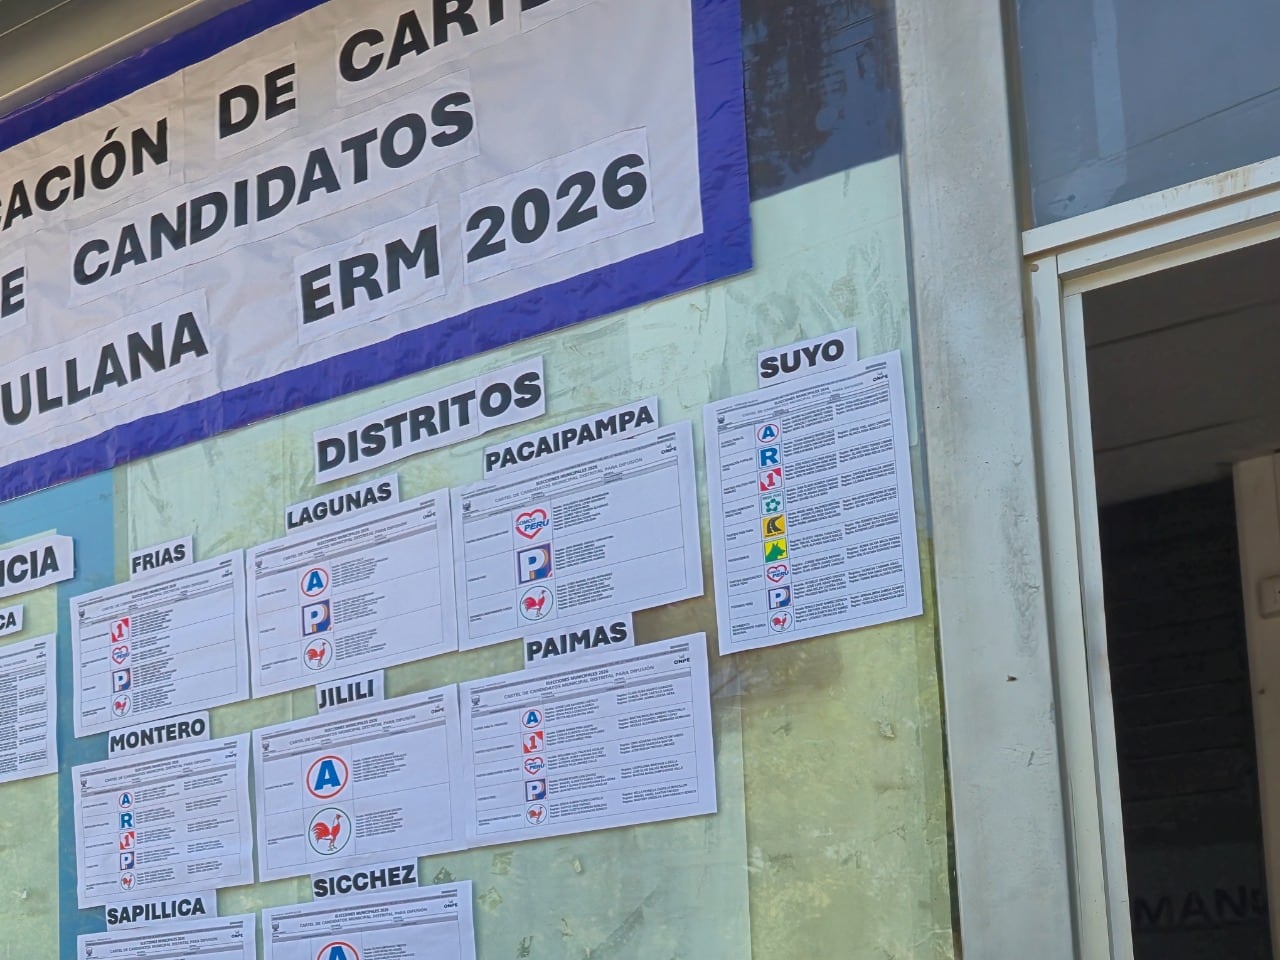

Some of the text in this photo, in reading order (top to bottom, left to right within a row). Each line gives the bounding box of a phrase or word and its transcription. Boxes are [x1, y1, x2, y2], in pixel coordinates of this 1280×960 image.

[219, 63, 296, 139] DE
[338, 0, 549, 82] CAR
[73, 91, 473, 286] CANDIDATOS
[300, 226, 440, 324] ERM
[466, 153, 648, 263] 2026
[759, 338, 844, 379] SUYO
[317, 370, 542, 472] DISTRITOS
[761, 425, 776, 441] A
[485, 406, 655, 472] PACAIPAMPA
[760, 447, 779, 467] R
[286, 482, 392, 529] LAGUNAS
[523, 518, 550, 532] PERU
[131, 544, 186, 574] FRIAS
[305, 570, 324, 593] A
[526, 621, 627, 661] PAIMAS
[319, 679, 374, 709] JILILI
[526, 710, 539, 726] A
[110, 718, 206, 752] MONTERO
[314, 759, 341, 791] A
[121, 812, 133, 829] R
[313, 864, 417, 898] SICCHEZ
[106, 897, 206, 925] SAPILLICA
